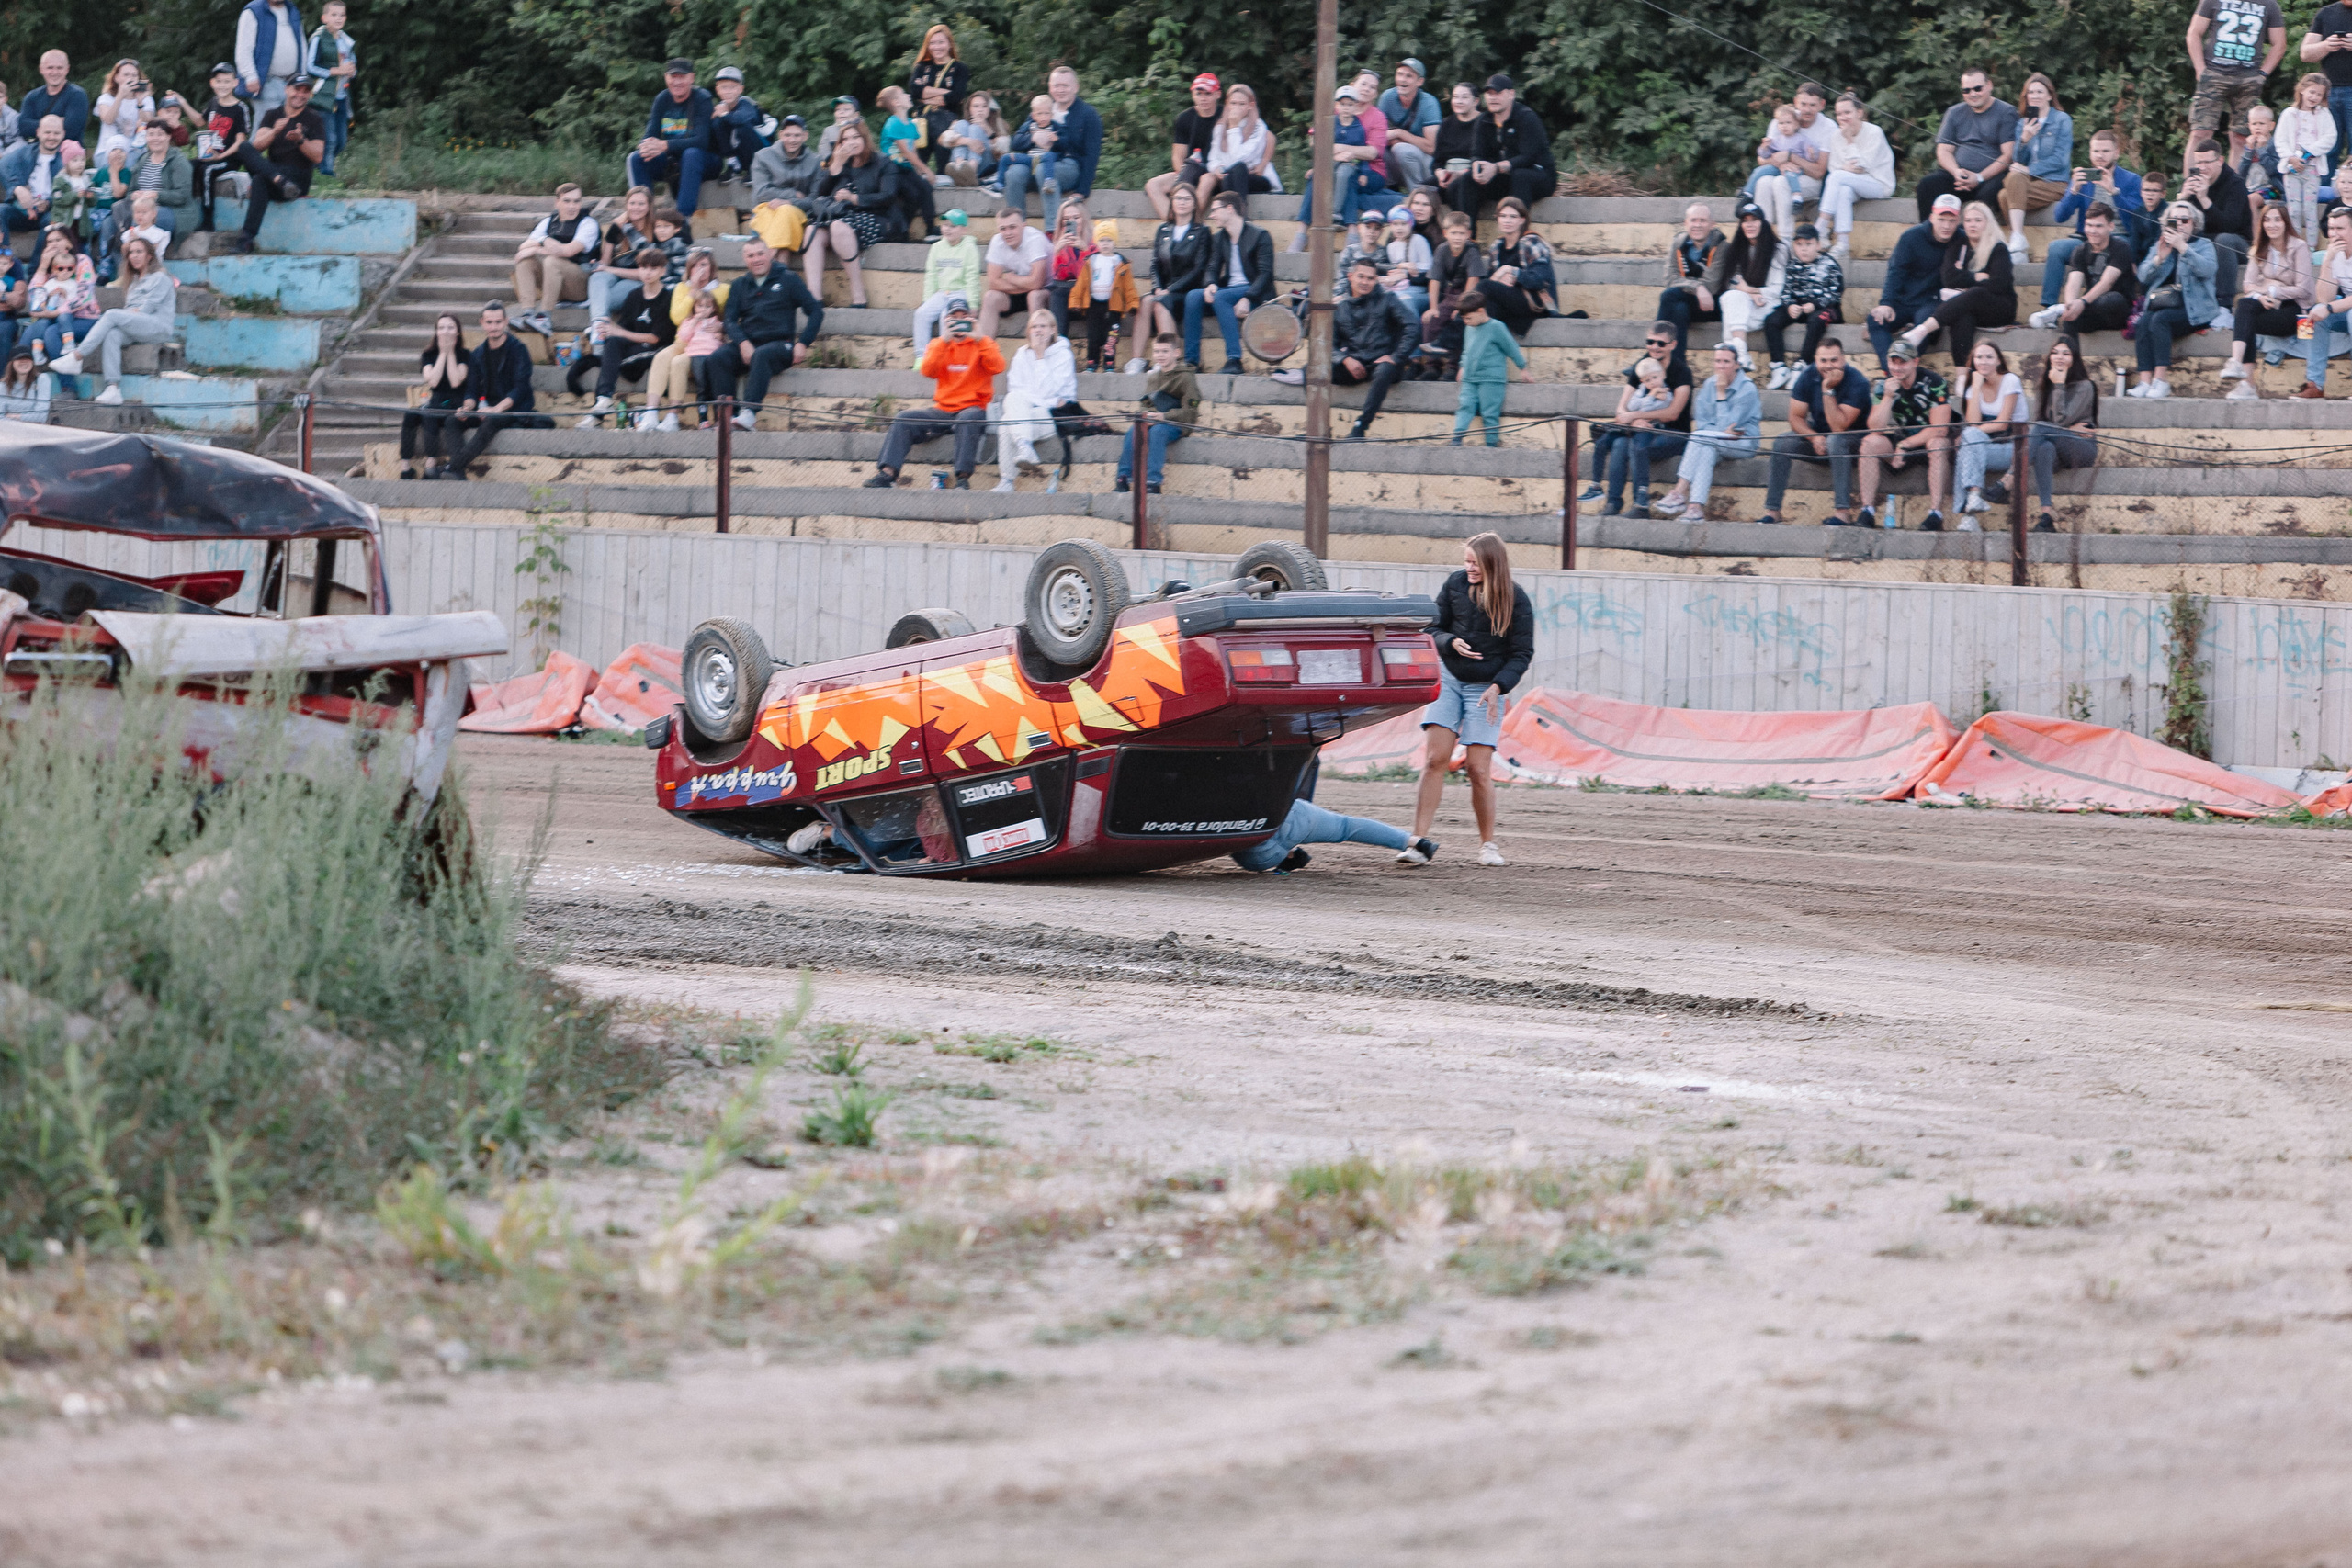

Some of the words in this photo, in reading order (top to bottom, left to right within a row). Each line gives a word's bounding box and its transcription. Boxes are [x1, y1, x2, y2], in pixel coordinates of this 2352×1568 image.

[2219, 0, 2266, 17] TEAM
[2216, 10, 2263, 46] 23
[2213, 41, 2256, 61] STOP
[815, 744, 892, 791] SPORT
[1141, 821, 1196, 831] 39-00-01
[1196, 818, 1258, 832] Pandora
